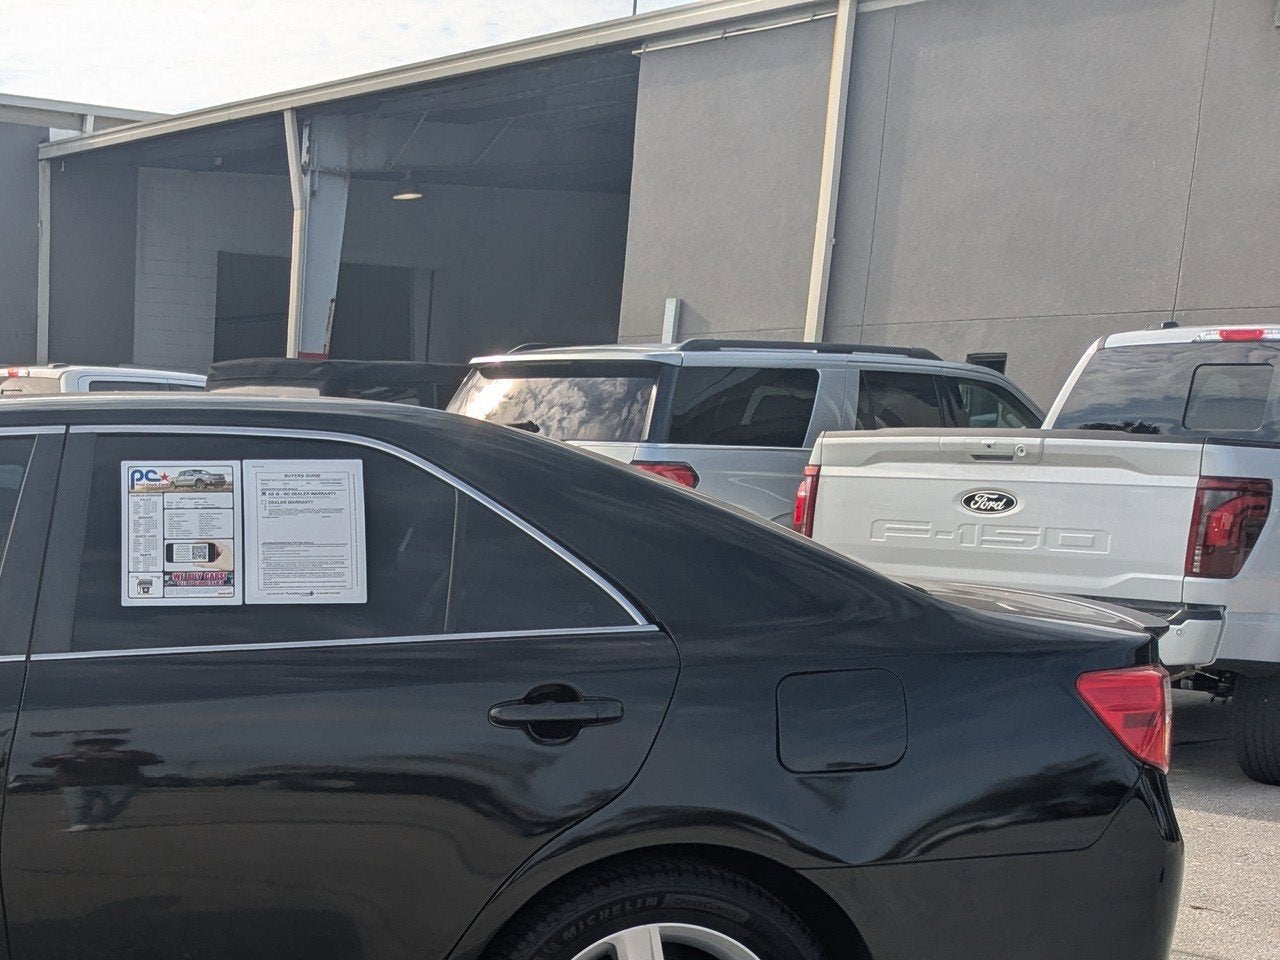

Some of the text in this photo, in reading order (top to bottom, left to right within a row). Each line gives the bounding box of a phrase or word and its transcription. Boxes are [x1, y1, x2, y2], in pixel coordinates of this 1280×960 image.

[970, 493, 1007, 510] Ford
[870, 518, 1111, 554] F-150
[562, 896, 659, 942] MICHELIN
